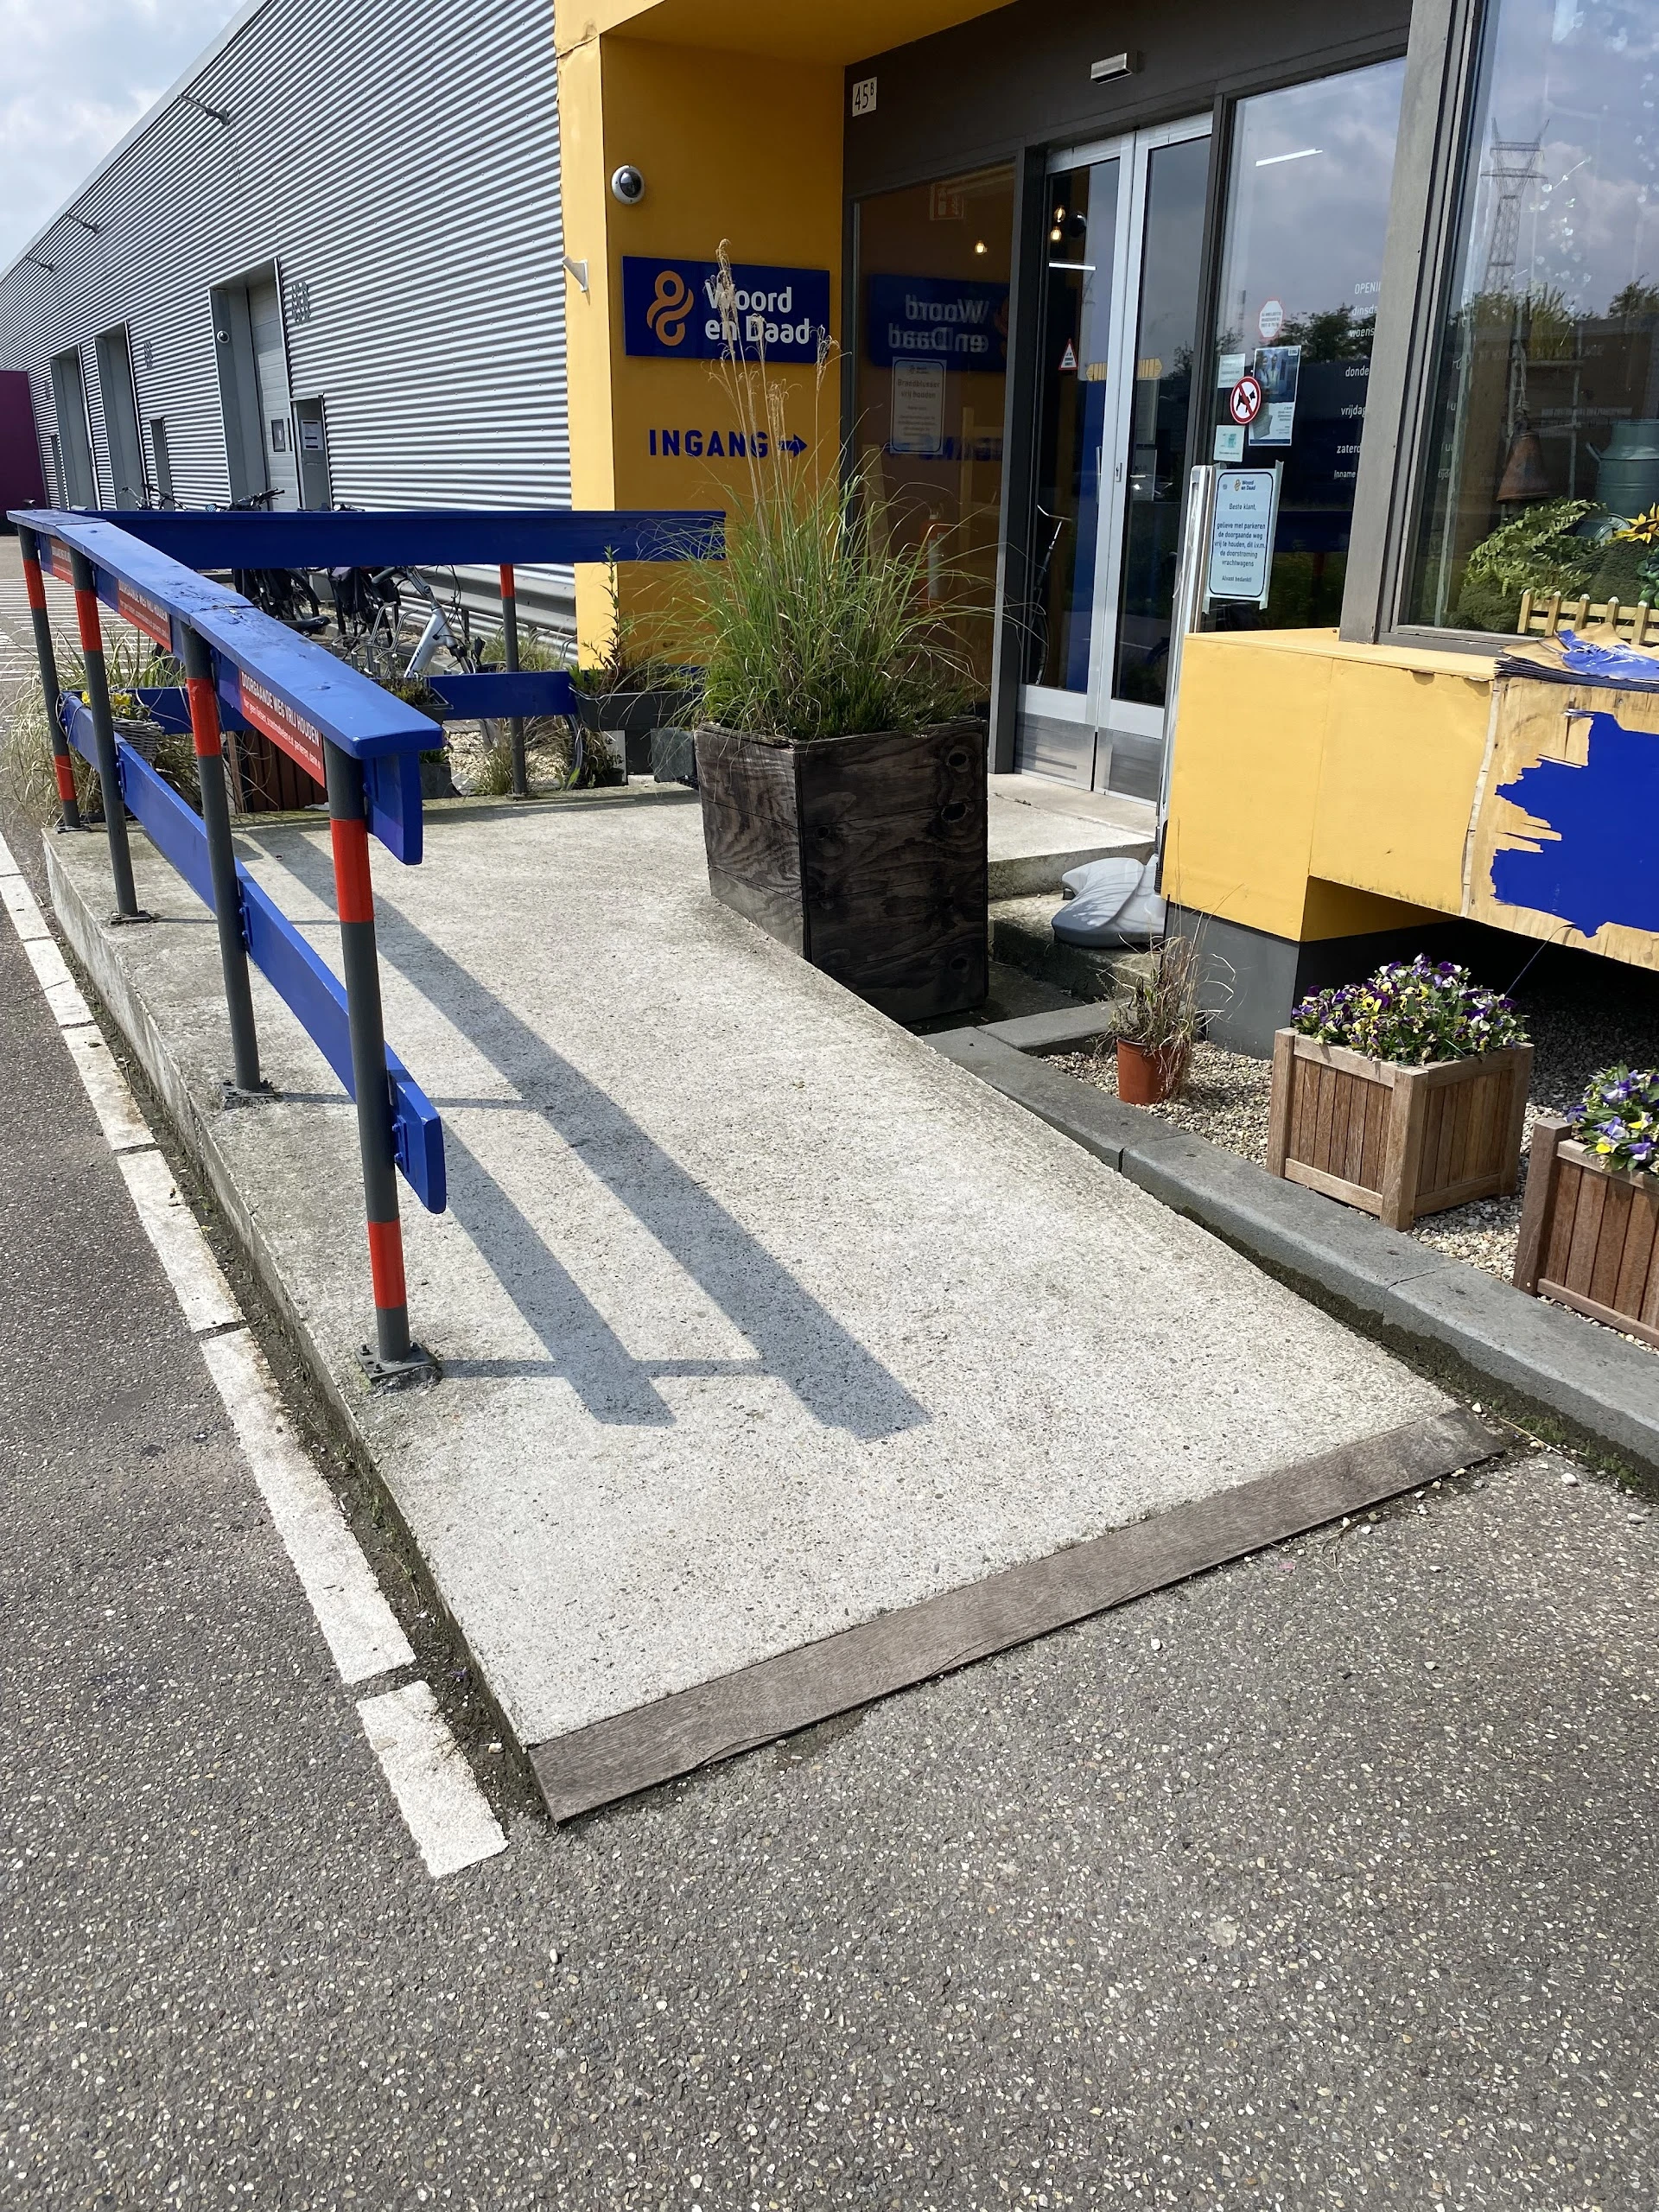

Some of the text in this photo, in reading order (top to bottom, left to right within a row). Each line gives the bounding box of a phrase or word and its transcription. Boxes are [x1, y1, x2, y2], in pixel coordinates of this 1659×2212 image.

[704, 281, 792, 314] Woord
[705, 315, 810, 345] en Daad
[650, 429, 768, 459] INGANG
[1225, 531, 1252, 540] doorgaande
[1227, 550, 1258, 559] doorstroming
[241, 671, 320, 747] DOORGAANDE WEG VRIJ HOUDEN
